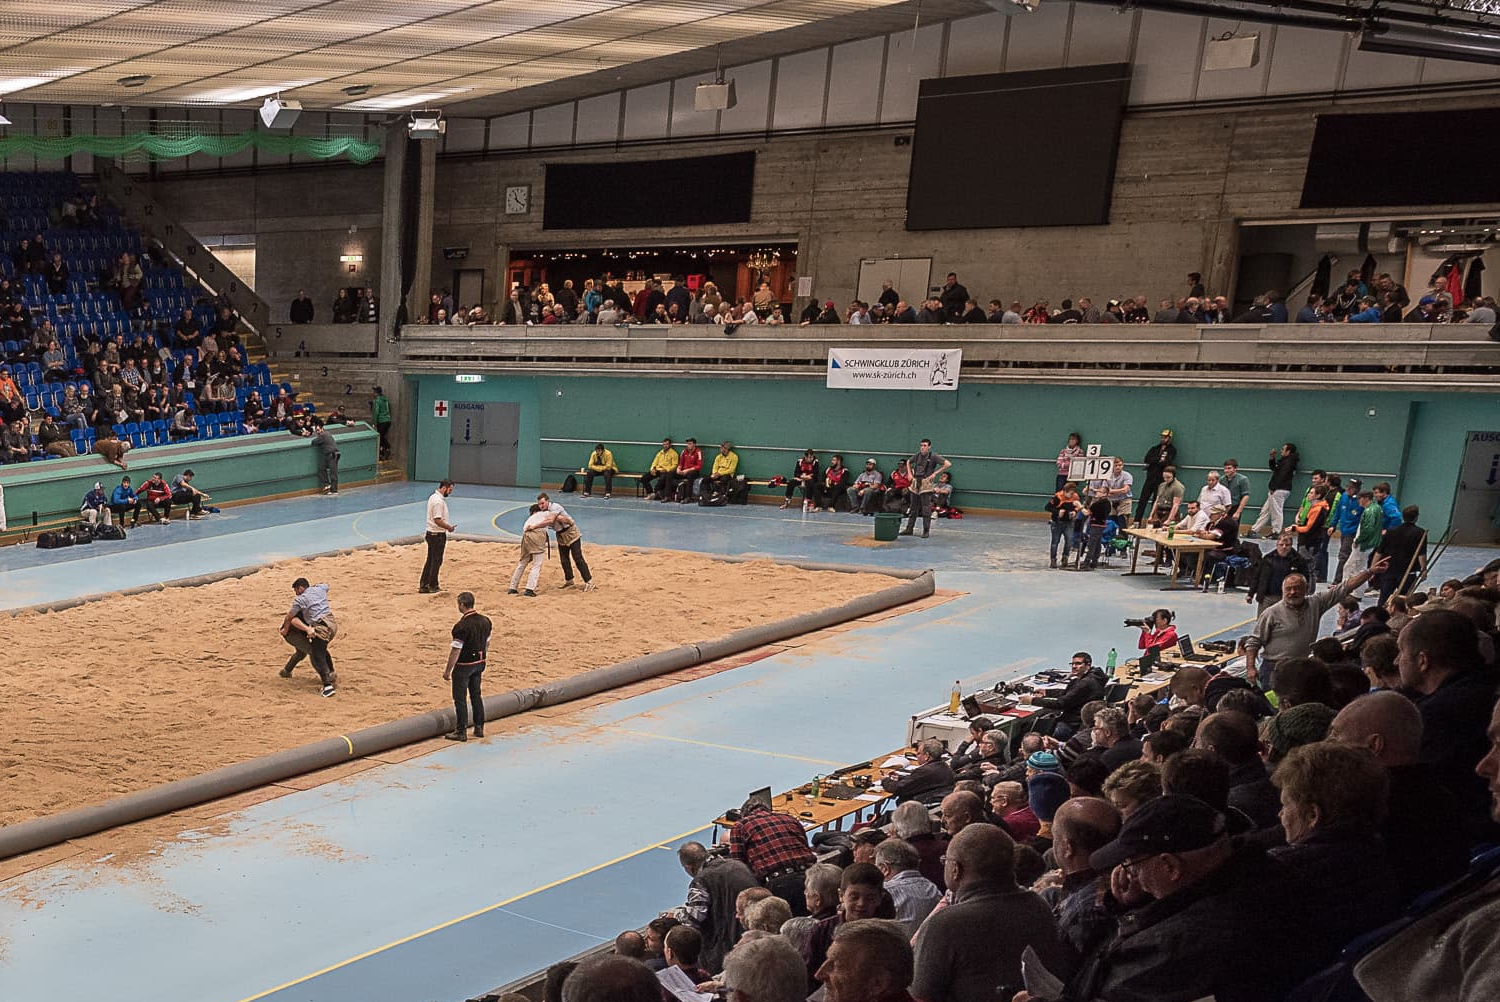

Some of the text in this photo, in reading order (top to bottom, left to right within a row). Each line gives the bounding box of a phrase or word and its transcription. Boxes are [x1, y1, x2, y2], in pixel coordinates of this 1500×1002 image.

[276, 327, 282, 338] 5
[299, 340, 306, 350] 4
[844, 358, 930, 368] SCHWINGKLUB ZÜRICH
[322, 366, 328, 377] 3
[346, 384, 352, 395] 2
[1090, 446, 1098, 456] 3
[1087, 460, 1111, 475] 19
